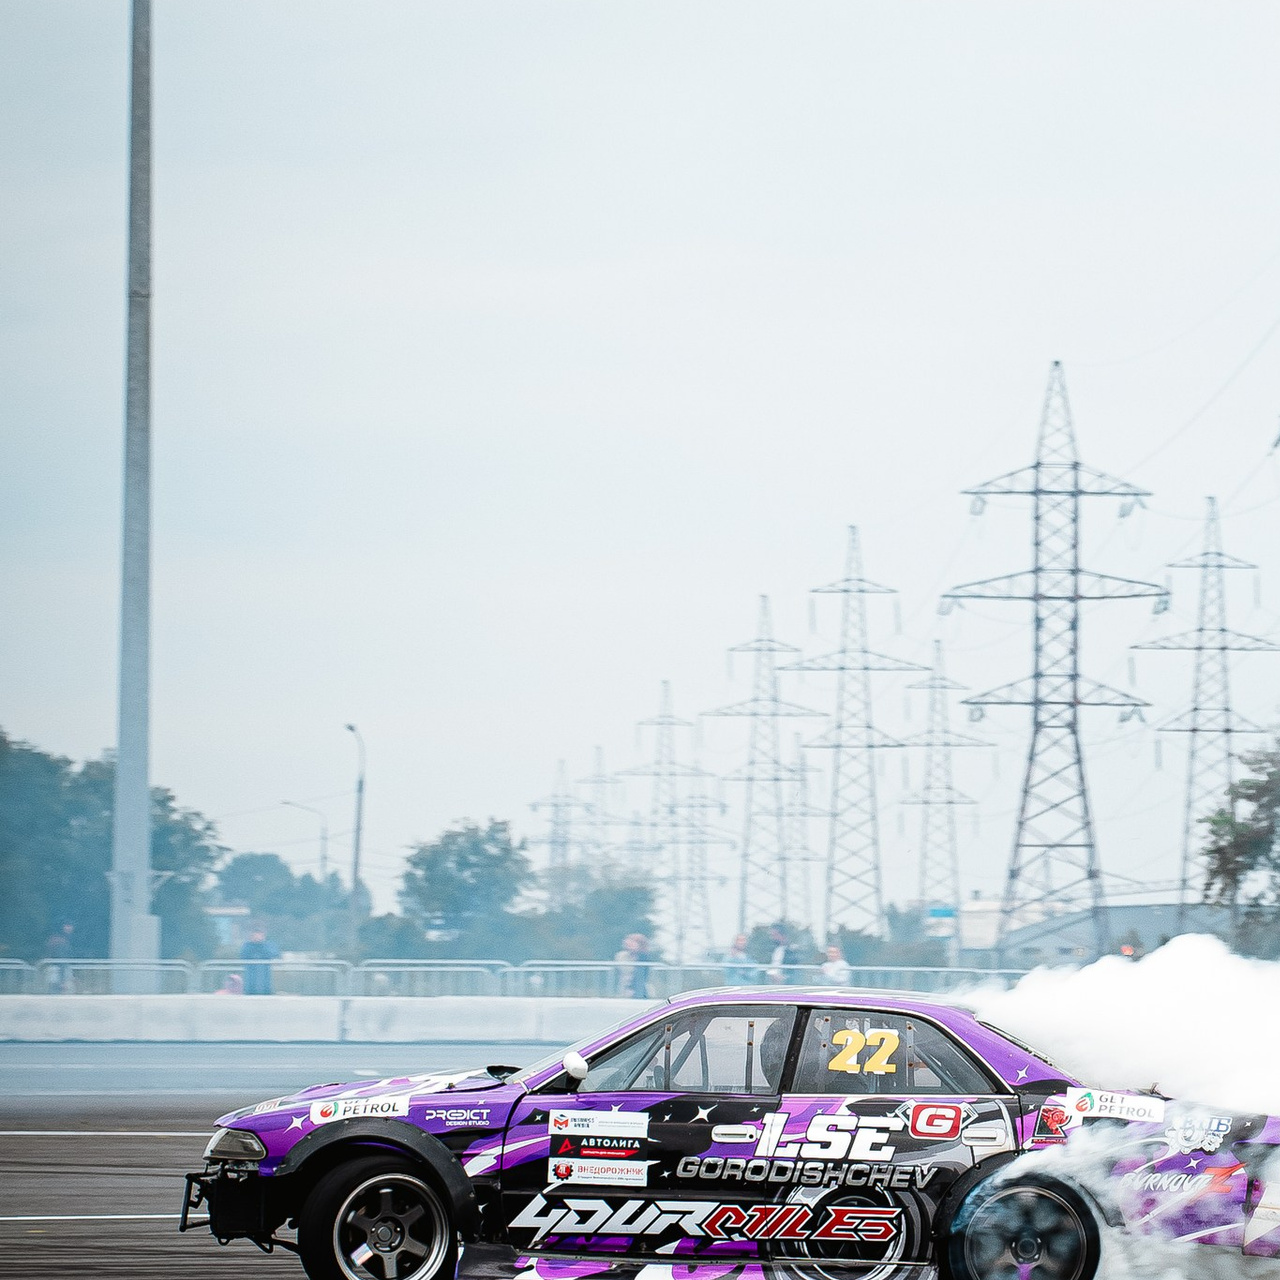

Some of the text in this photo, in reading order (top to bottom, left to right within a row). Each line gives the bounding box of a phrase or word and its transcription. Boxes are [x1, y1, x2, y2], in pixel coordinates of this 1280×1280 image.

[828, 1029, 900, 1074] 22
[1099, 1093, 1125, 1104] GET
[343, 1102, 399, 1116] PETROL
[1098, 1104, 1155, 1118] PETROL
[580, 1138, 640, 1148] АВТОЛИГА
[754, 1112, 904, 1162] LSE
[577, 1165, 644, 1176] ВНЕДОРОЖНИК
[676, 1156, 938, 1189] GORODISHCHEV
